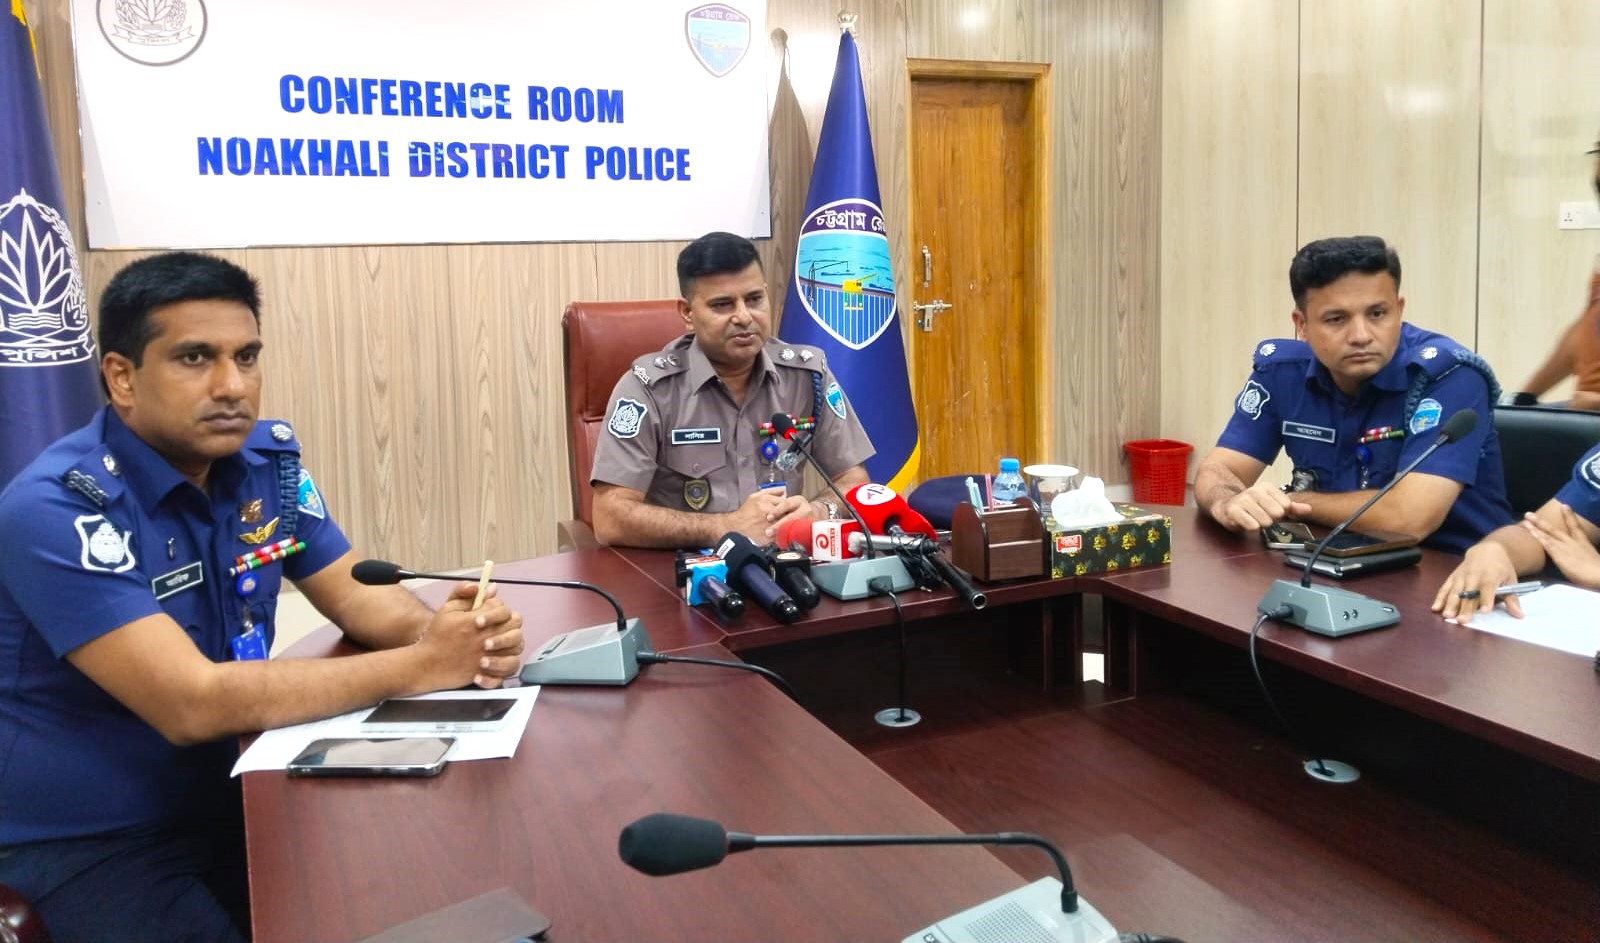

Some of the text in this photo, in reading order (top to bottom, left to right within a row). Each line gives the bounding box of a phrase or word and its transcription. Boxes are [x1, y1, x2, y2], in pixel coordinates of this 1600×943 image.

[279, 73, 625, 125] CONFERENCE ROOM
[197, 136, 692, 182] NOAKHALI DISTRICT POLICE
[815, 208, 867, 230] চট্টগ্রাম
[0, 346, 78, 364] পুলিশ
